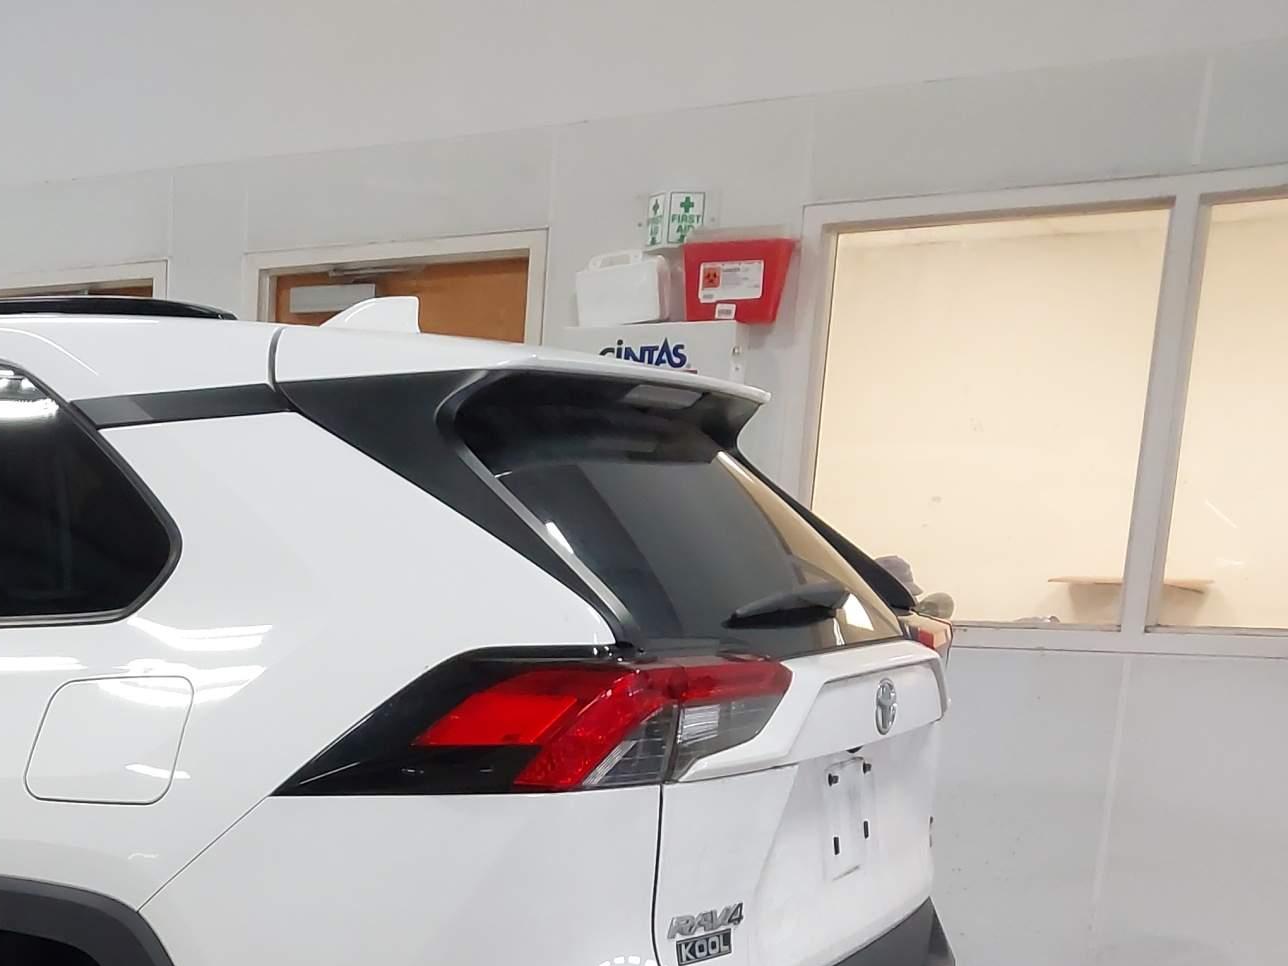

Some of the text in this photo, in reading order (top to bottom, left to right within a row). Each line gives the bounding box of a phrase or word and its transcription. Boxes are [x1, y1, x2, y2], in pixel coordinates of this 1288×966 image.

[671, 213, 702, 225] FIRST
[667, 902, 744, 939] RAV4
[681, 934, 730, 962] KOOL
